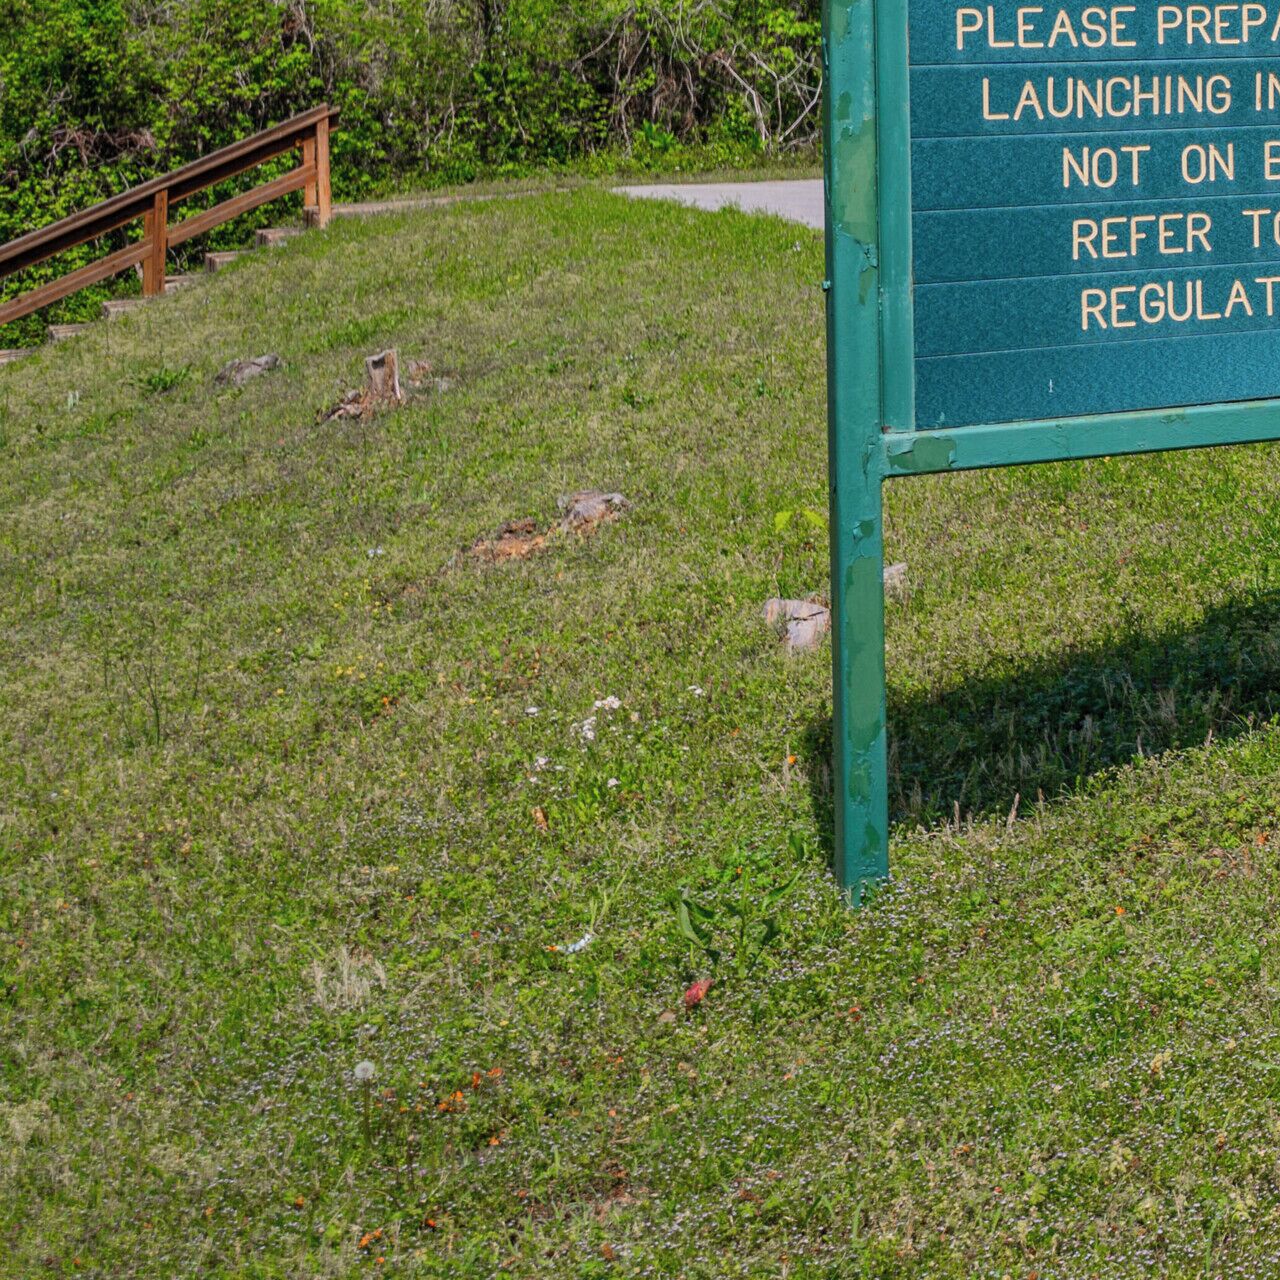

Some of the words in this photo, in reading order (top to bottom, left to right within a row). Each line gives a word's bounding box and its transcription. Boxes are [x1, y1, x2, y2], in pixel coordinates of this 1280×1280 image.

[955, 4, 1137, 51] PLEASE
[982, 74, 1232, 122] LAUNCHING
[1062, 145, 1151, 189] NOT
[1181, 142, 1235, 185] ON
[1071, 212, 1213, 261] REFER
